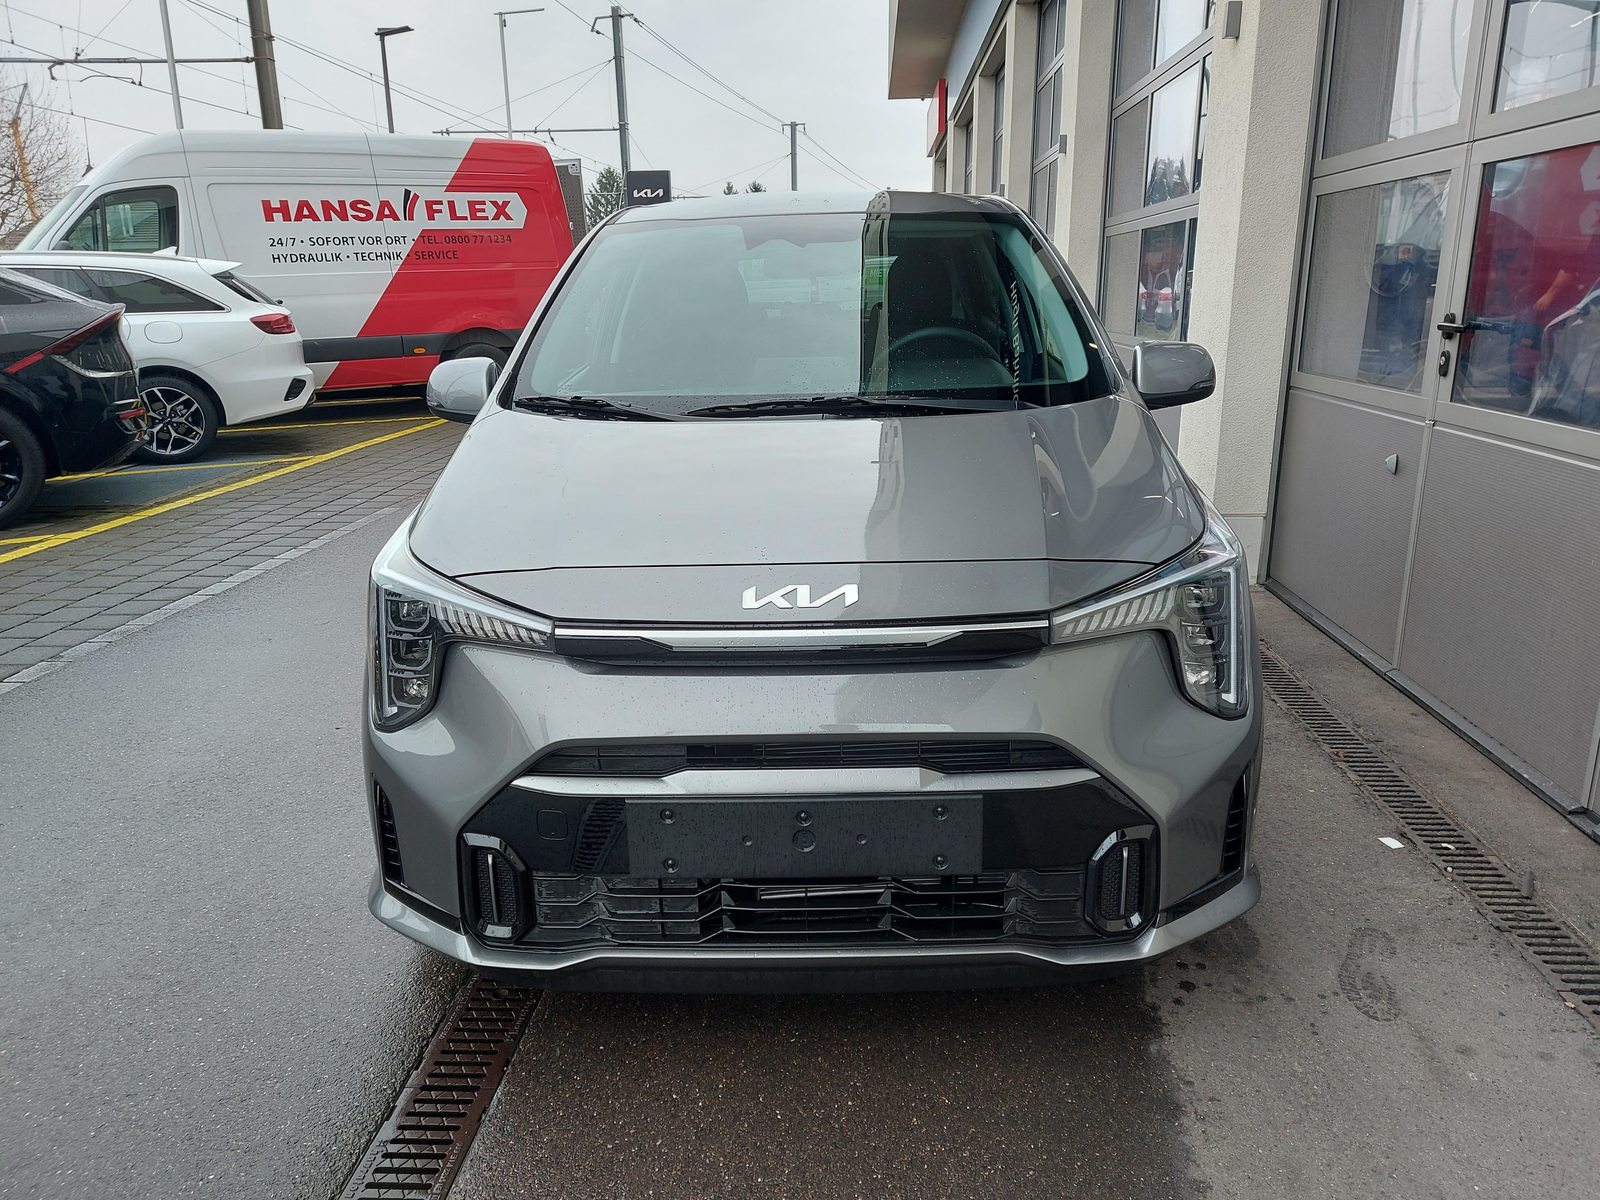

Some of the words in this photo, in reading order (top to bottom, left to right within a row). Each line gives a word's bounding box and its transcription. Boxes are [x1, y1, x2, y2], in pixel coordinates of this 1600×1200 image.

[261, 199, 401, 222] HANSA
[424, 199, 514, 221] FLEX
[268, 237, 296, 247] 24/7
[308, 236, 355, 247] SOFORT
[358, 236, 382, 246] VOR
[385, 235, 408, 245] ORT
[420, 235, 443, 245] TEL.
[444, 235, 470, 244] 0800
[471, 235, 485, 244] 77
[488, 235, 512, 244] 1234
[271, 252, 343, 263] HYDRAULIK
[353, 251, 404, 262] TECHNIK
[414, 250, 459, 260] SERVICE
[742, 584, 859, 609] KIA
